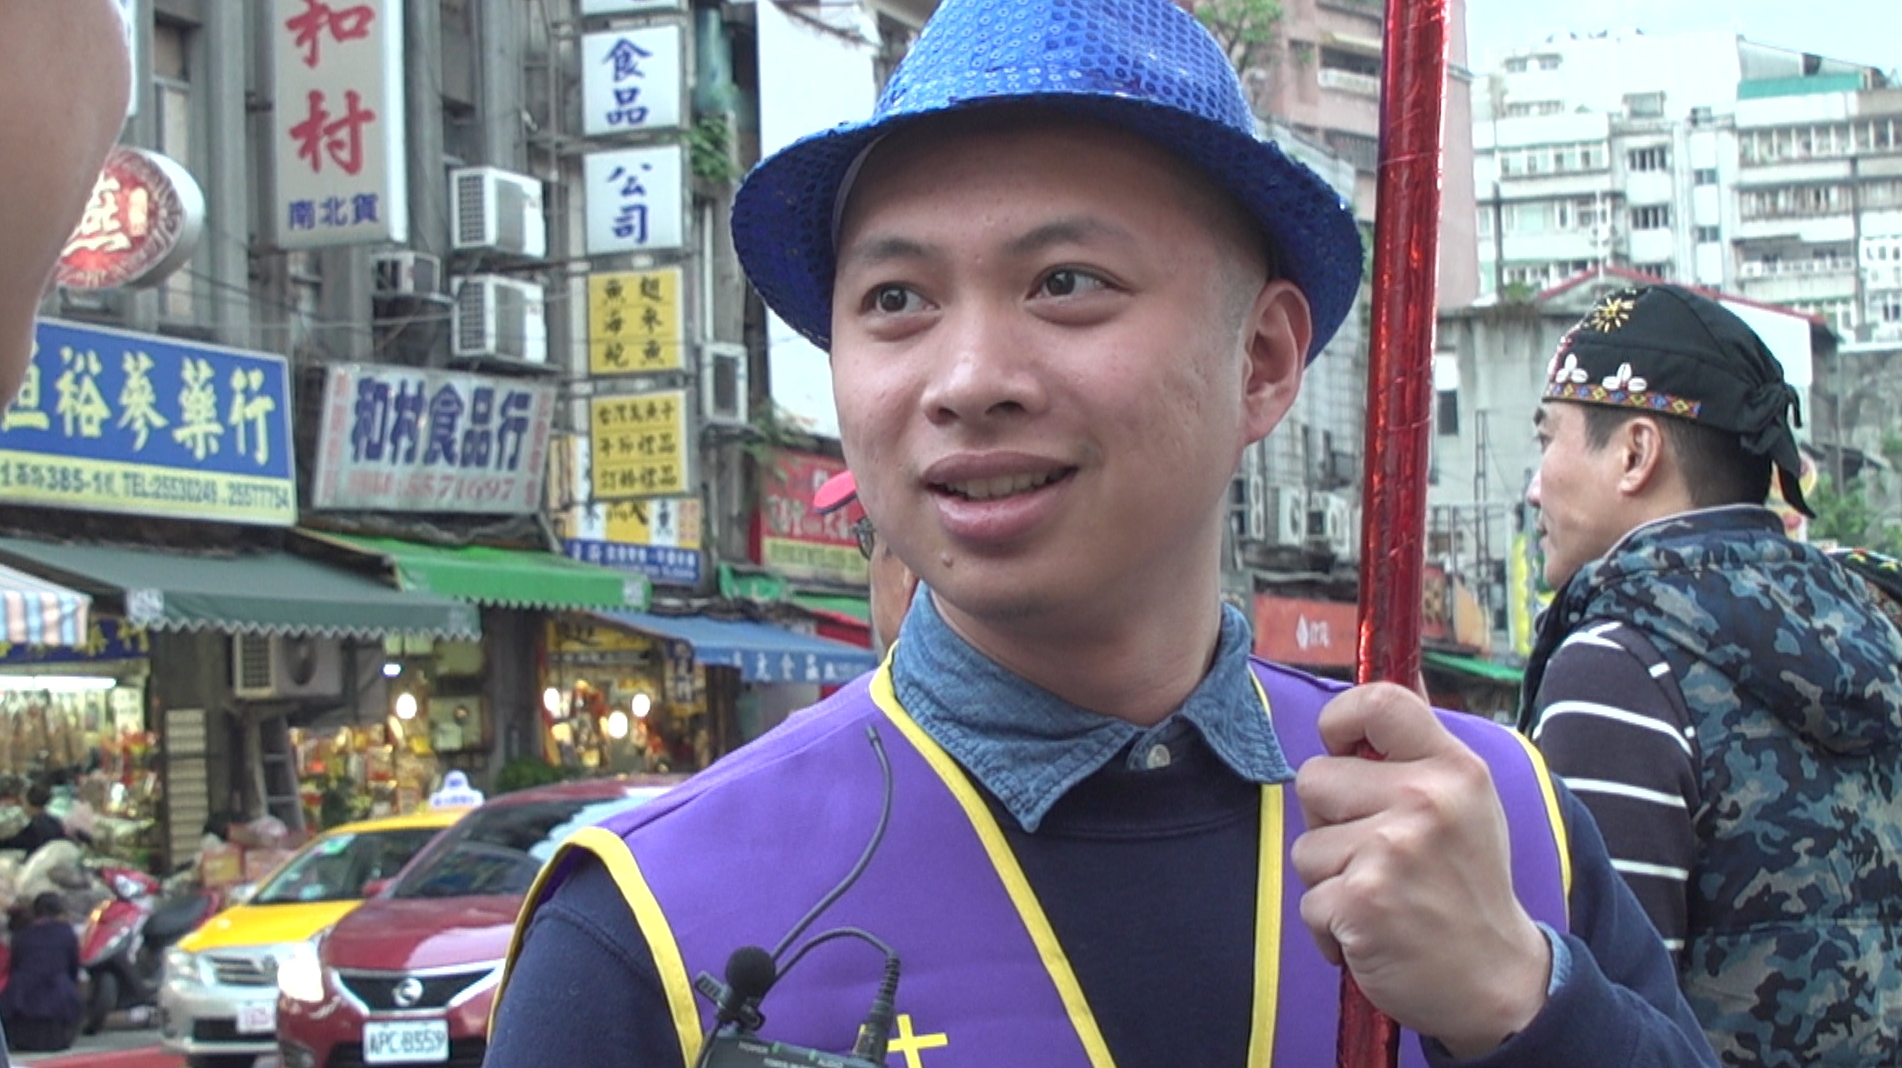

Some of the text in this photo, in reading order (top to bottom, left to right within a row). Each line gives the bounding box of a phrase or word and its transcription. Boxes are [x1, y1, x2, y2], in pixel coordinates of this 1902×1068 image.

[285, 0, 376, 175] 和村
[602, 37, 654, 126] 食品
[288, 192, 380, 231] 南北貨
[606, 162, 653, 245] 公司
[351, 376, 533, 471] 和村食品行
